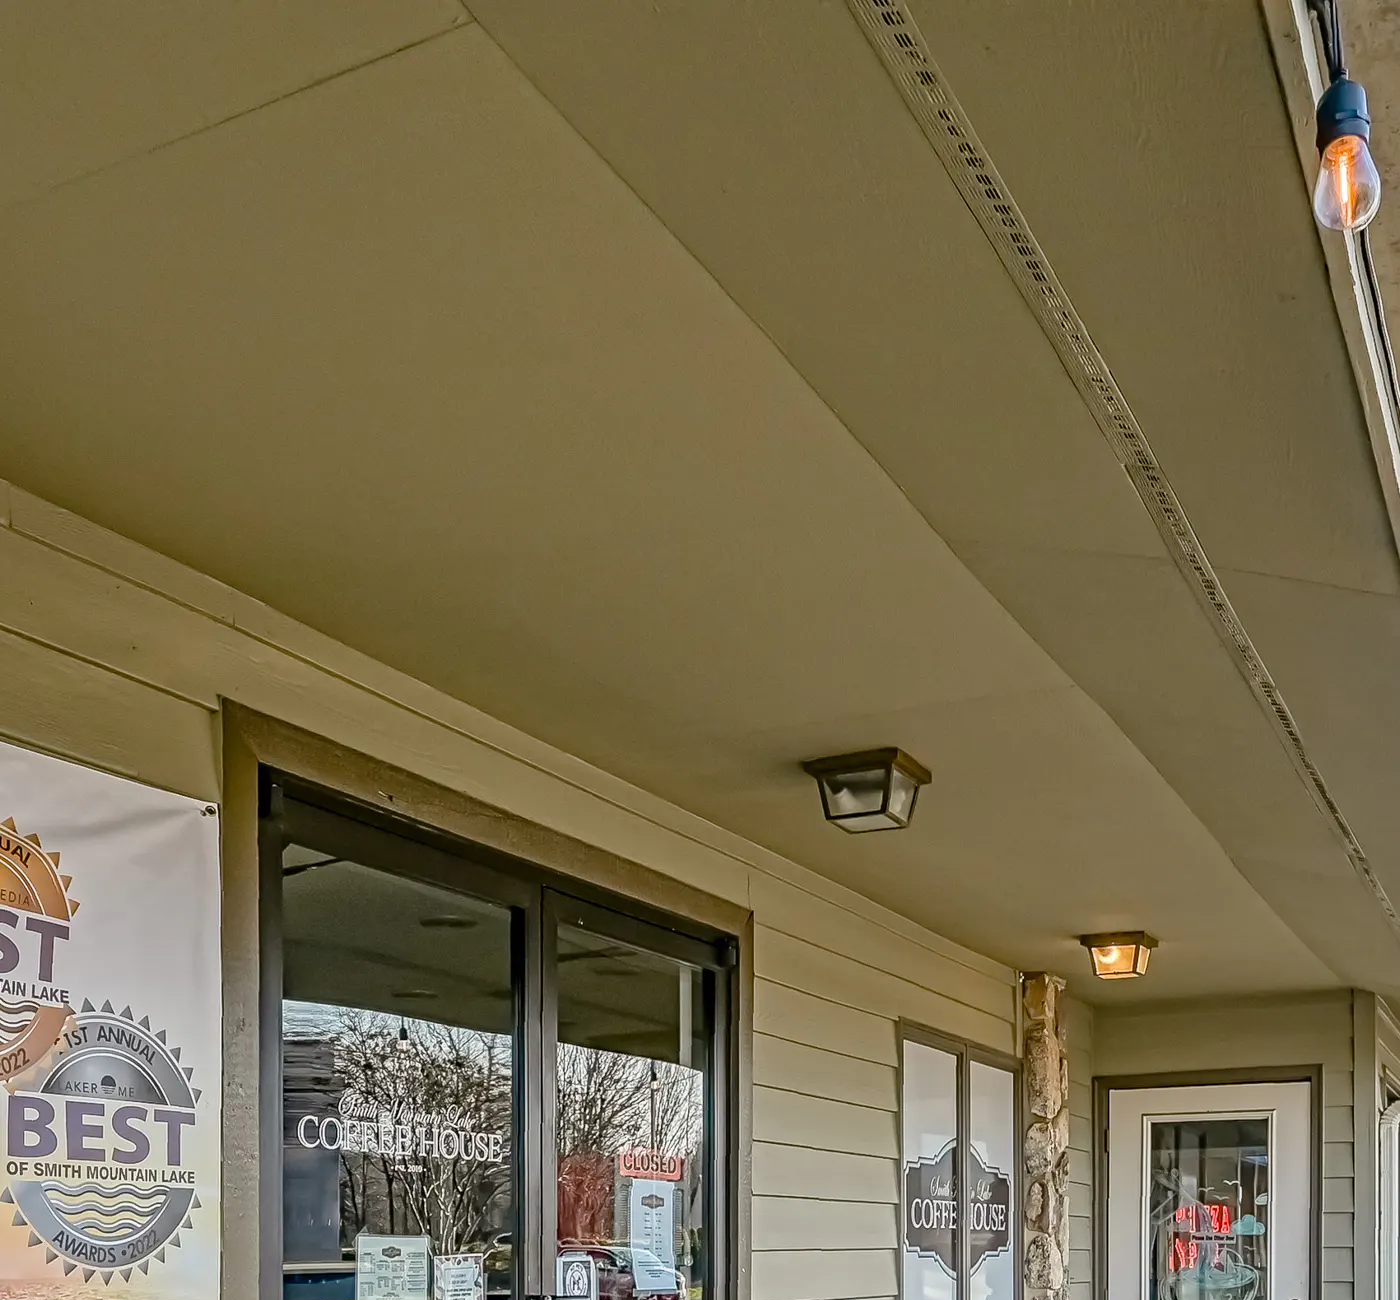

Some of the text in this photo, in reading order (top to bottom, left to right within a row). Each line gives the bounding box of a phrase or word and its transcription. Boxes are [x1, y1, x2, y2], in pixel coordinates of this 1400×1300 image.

[0, 979, 69, 1004] AIN LAKE
[54, 1025, 156, 1066] 1ST ANNUAL
[0, 1047, 30, 1077] 022
[65, 1081, 98, 1095] AKER
[8, 1095, 195, 1167] BEST
[297, 1115, 503, 1162] COFFEE HOUSE
[6, 1161, 195, 1184] OF SMITH MOUNTAIN LAKE
[623, 1152, 676, 1174] CLOSED
[911, 1198, 957, 1229] COFFE
[1176, 1204, 1230, 1234] PIZA
[52, 1229, 161, 1263] AWARDS 2022
